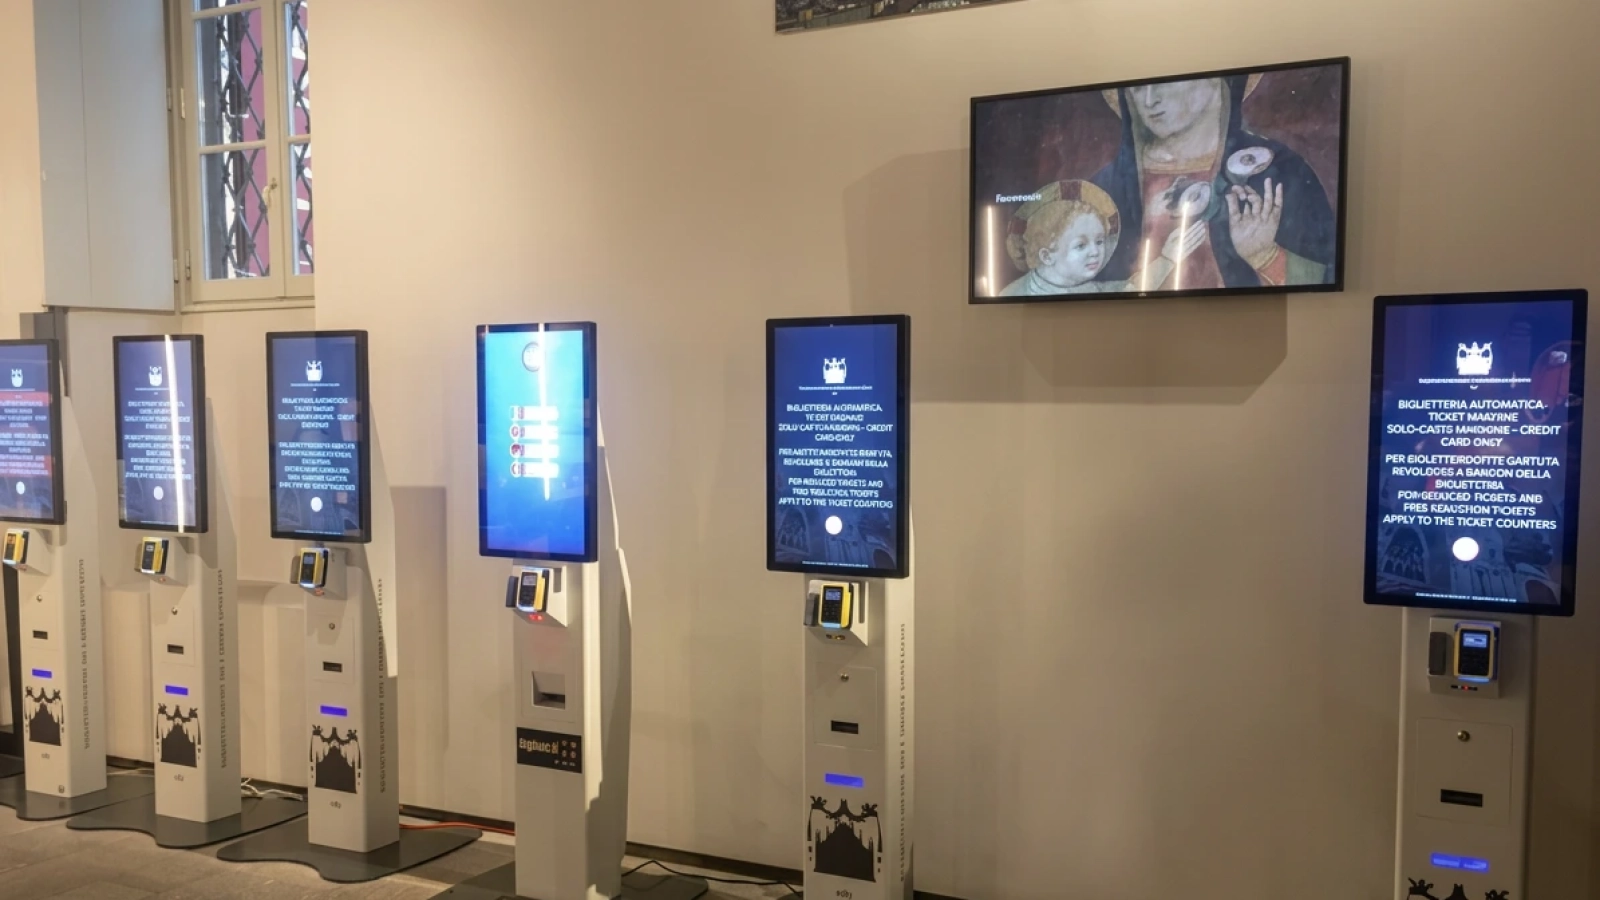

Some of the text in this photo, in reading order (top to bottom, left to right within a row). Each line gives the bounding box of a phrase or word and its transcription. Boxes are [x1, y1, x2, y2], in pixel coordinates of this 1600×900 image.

[1428, 411, 1465, 421] TICKET
[1519, 425, 1561, 435] CREDIT
[1440, 437, 1471, 447] CARD
[1385, 454, 1406, 464] PER
[1382, 514, 1416, 525] APPLY
[1417, 515, 1432, 526] TO
[1433, 516, 1455, 526] THE
[1495, 518, 1557, 530] COUNTERS
